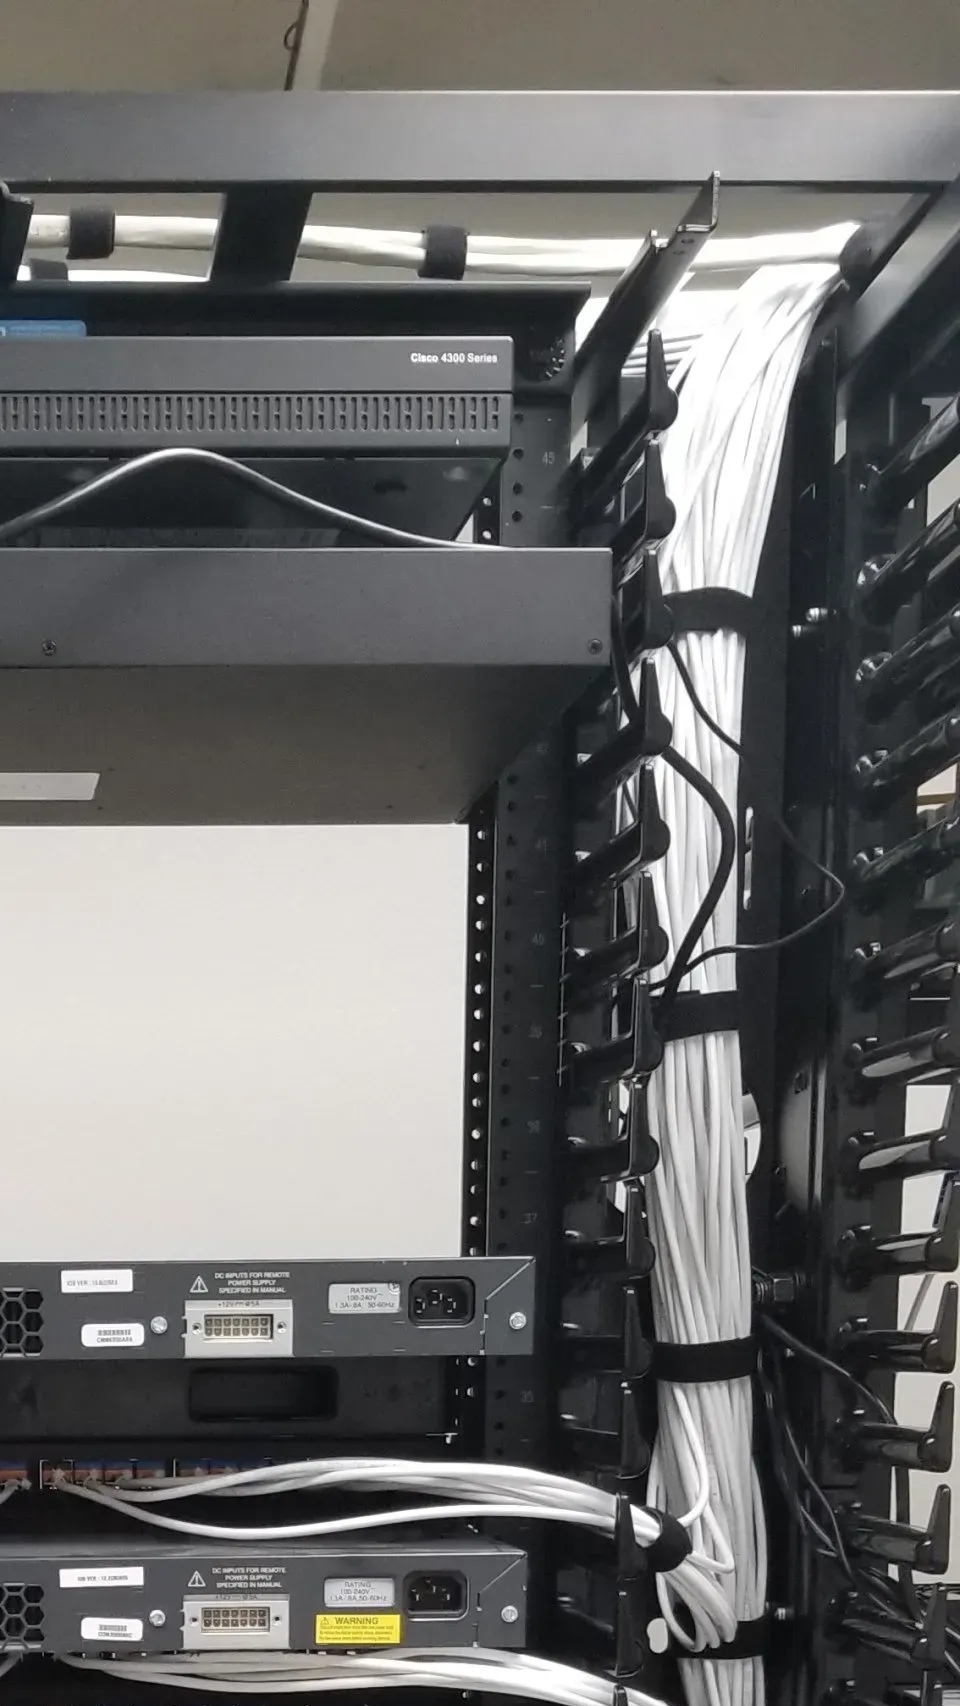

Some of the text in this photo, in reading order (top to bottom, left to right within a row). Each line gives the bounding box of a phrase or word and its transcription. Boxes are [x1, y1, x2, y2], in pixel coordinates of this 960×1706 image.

[410, 353, 497, 363] Cisco 4300 Series
[542, 451, 556, 465] 45
[335, 1617, 379, 1625] WARNING
